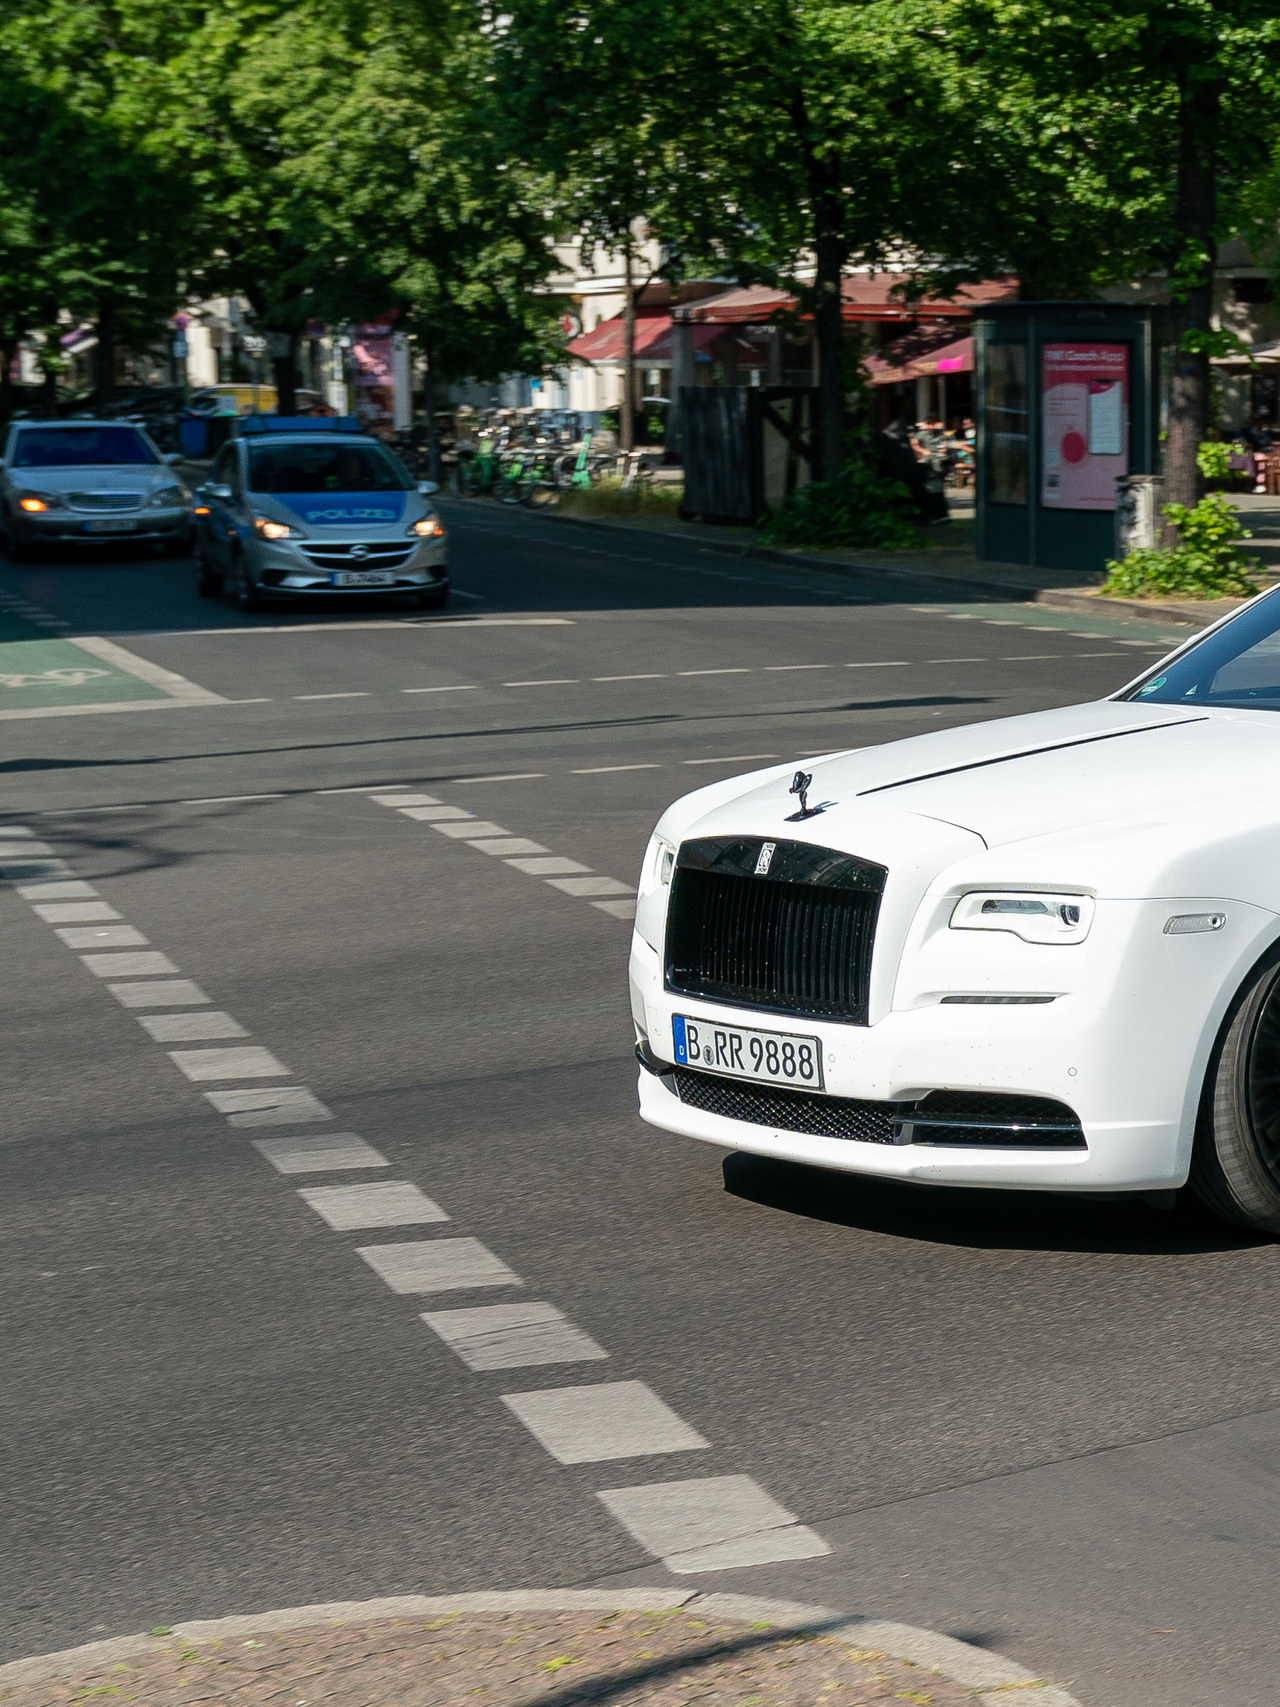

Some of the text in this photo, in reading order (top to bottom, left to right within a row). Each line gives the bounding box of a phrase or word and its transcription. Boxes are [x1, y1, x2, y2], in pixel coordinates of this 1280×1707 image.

[305, 508, 397, 520] POLIZEI
[687, 1024, 814, 1080] B RR 9888
